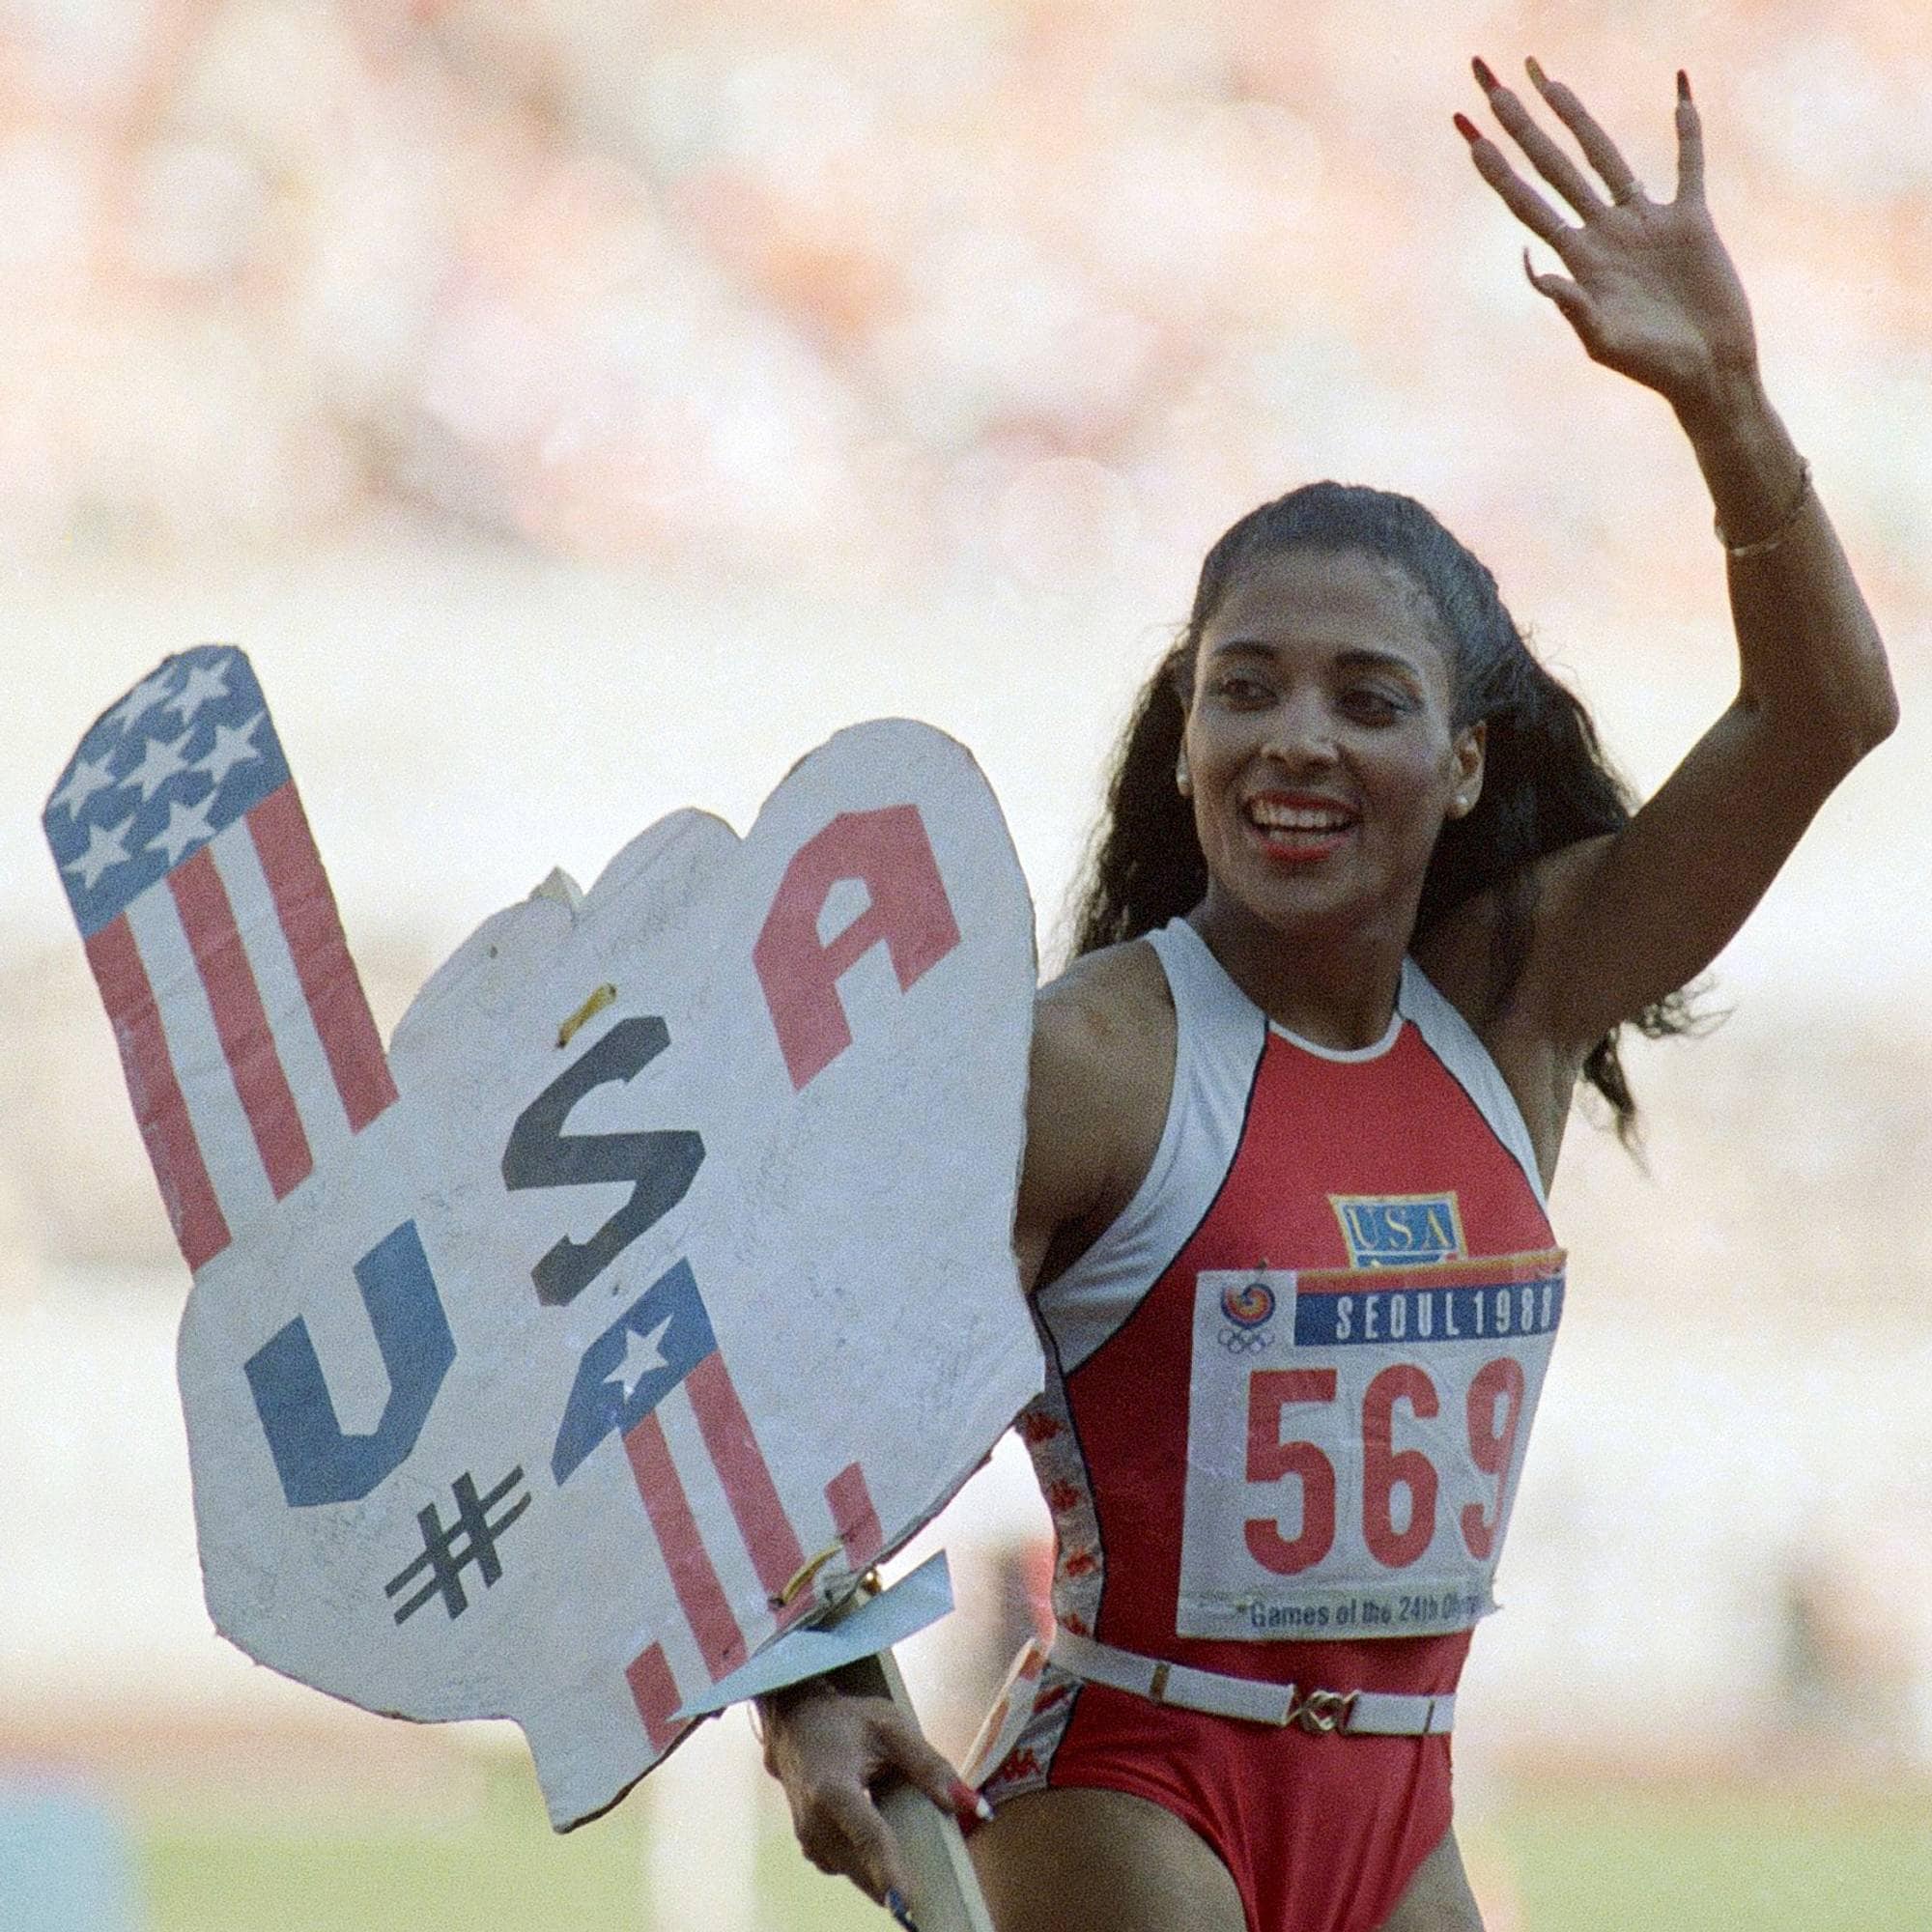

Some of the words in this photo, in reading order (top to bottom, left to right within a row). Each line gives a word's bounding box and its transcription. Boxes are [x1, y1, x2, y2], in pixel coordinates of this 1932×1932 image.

[243, 804, 961, 1507] USA
[1347, 1207, 1452, 1249] USA
[1336, 1293, 1460, 1340] SEOUL
[1244, 1356, 1525, 1576] 569
[1251, 1601, 1329, 1629] Games
[1336, 1598, 1356, 1624] of
[1361, 1598, 1391, 1624] the
